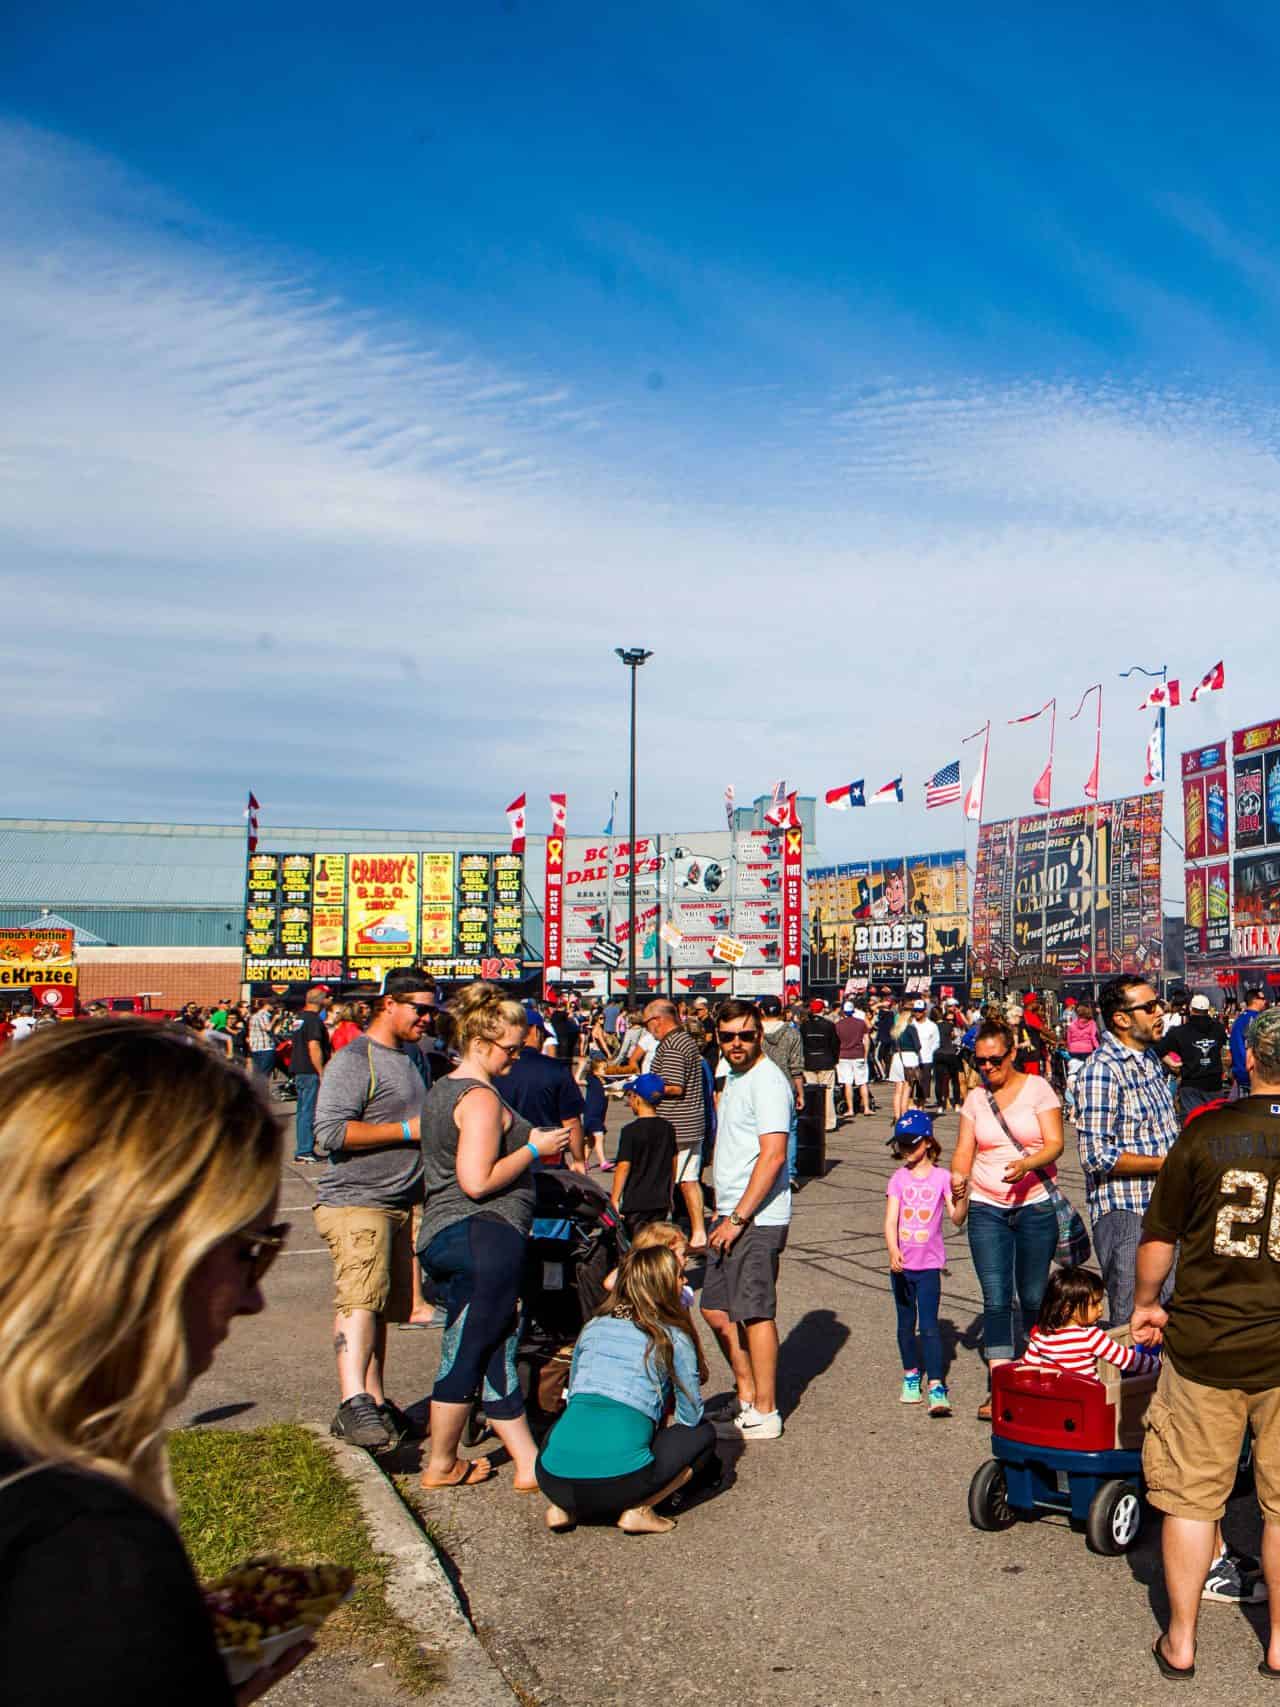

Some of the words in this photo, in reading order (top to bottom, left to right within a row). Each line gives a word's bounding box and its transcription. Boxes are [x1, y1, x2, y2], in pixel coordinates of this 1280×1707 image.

[584, 840, 649, 862] BONE
[352, 856, 416, 884] CRABBY'S
[566, 856, 664, 886] DADDY'S
[1070, 826, 1110, 916] 31
[1016, 862, 1068, 914] CAMP
[855, 923, 925, 950] BIBB'S
[1047, 918, 1076, 934] HEART
[1047, 935, 1060, 947] OF
[247, 967, 269, 980] BEST
[271, 967, 310, 980] CHICKEN
[456, 966, 481, 975] RIBS
